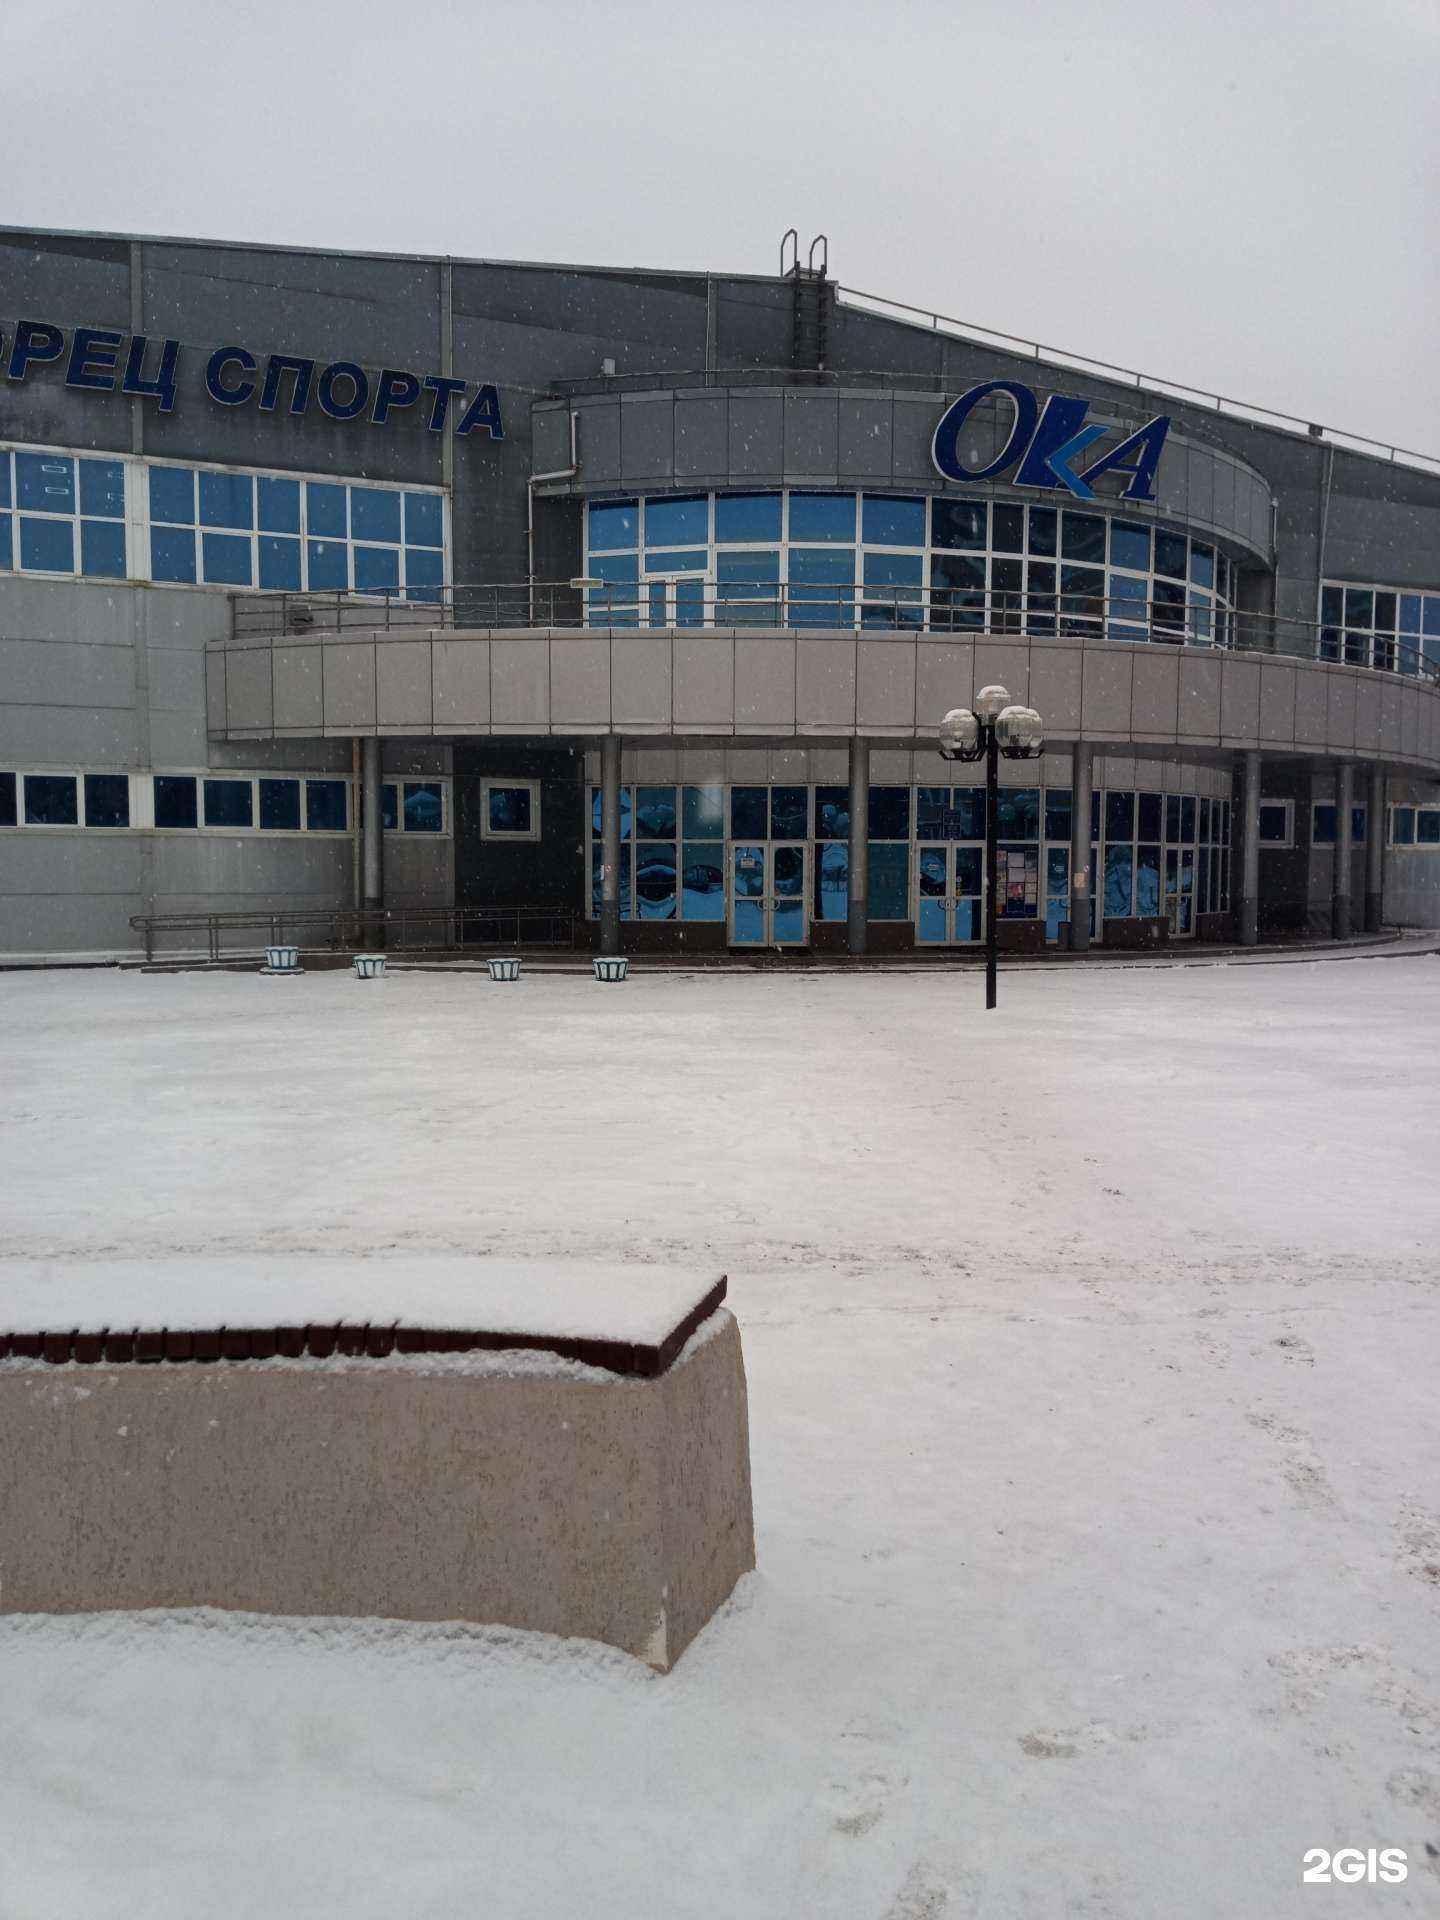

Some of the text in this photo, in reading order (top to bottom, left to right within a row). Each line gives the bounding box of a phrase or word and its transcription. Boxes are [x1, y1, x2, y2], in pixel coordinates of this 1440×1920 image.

[0, 320, 506, 440] РЕЦ СПОРТА
[931, 380, 1171, 501] ОКА
